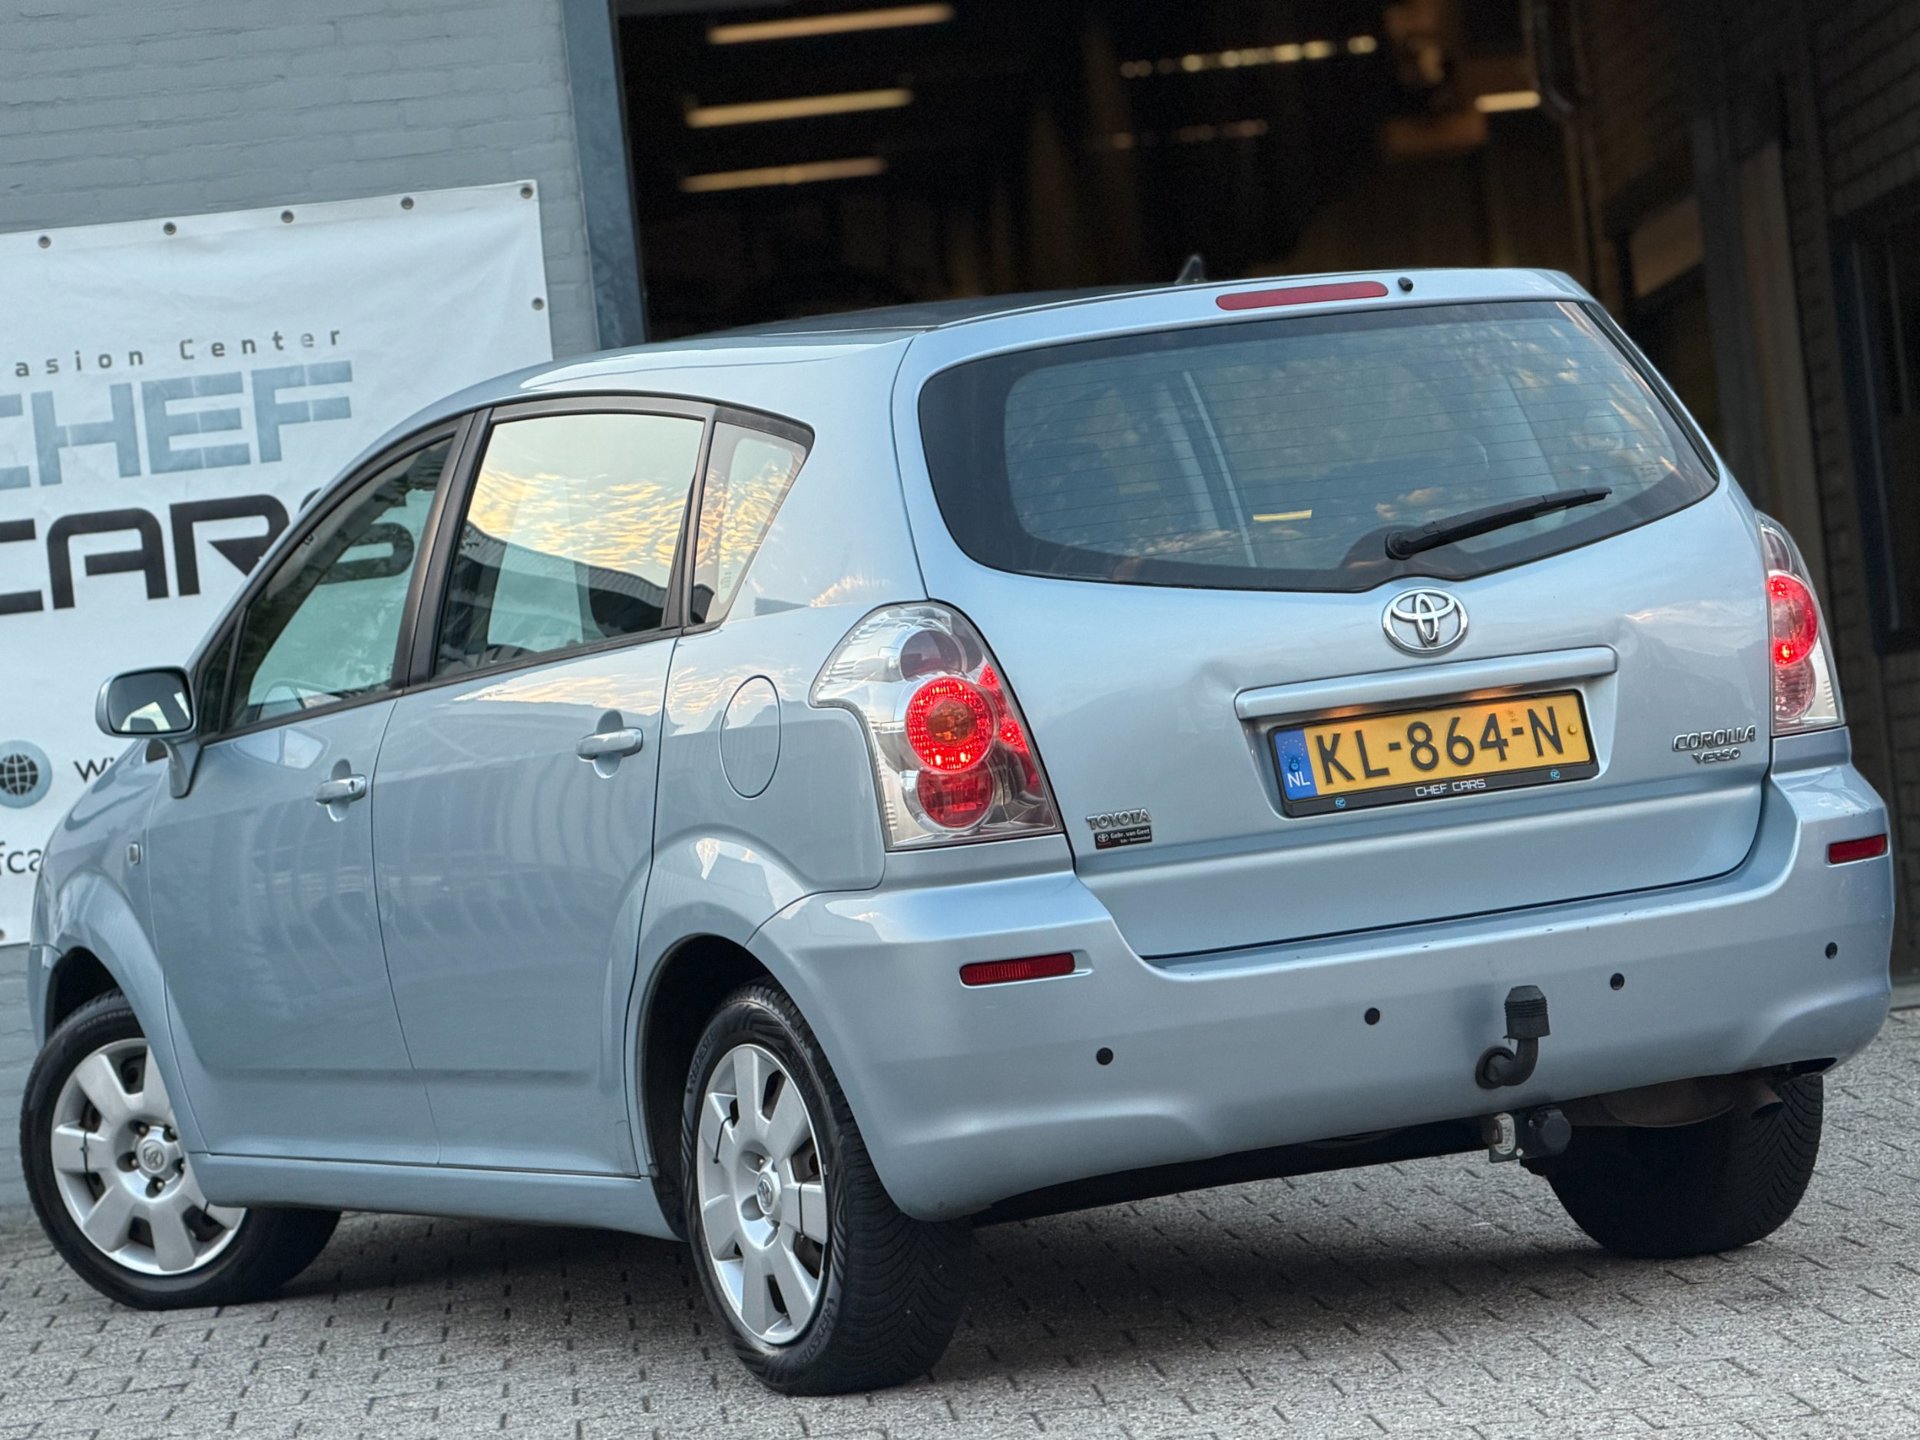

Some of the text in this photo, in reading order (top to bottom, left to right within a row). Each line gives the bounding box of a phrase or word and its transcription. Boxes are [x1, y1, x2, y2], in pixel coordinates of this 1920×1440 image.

[179, 328, 342, 361] Center
[0, 359, 353, 491] HEF
[1315, 705, 1565, 785] KL-864-N
[1672, 724, 1756, 752] COROLLA
[1691, 747, 1741, 764] VERSO
[1288, 772, 1311, 789] NL
[1414, 778, 1487, 798] CHEF CARS
[1085, 808, 1152, 830] TOYOTA
